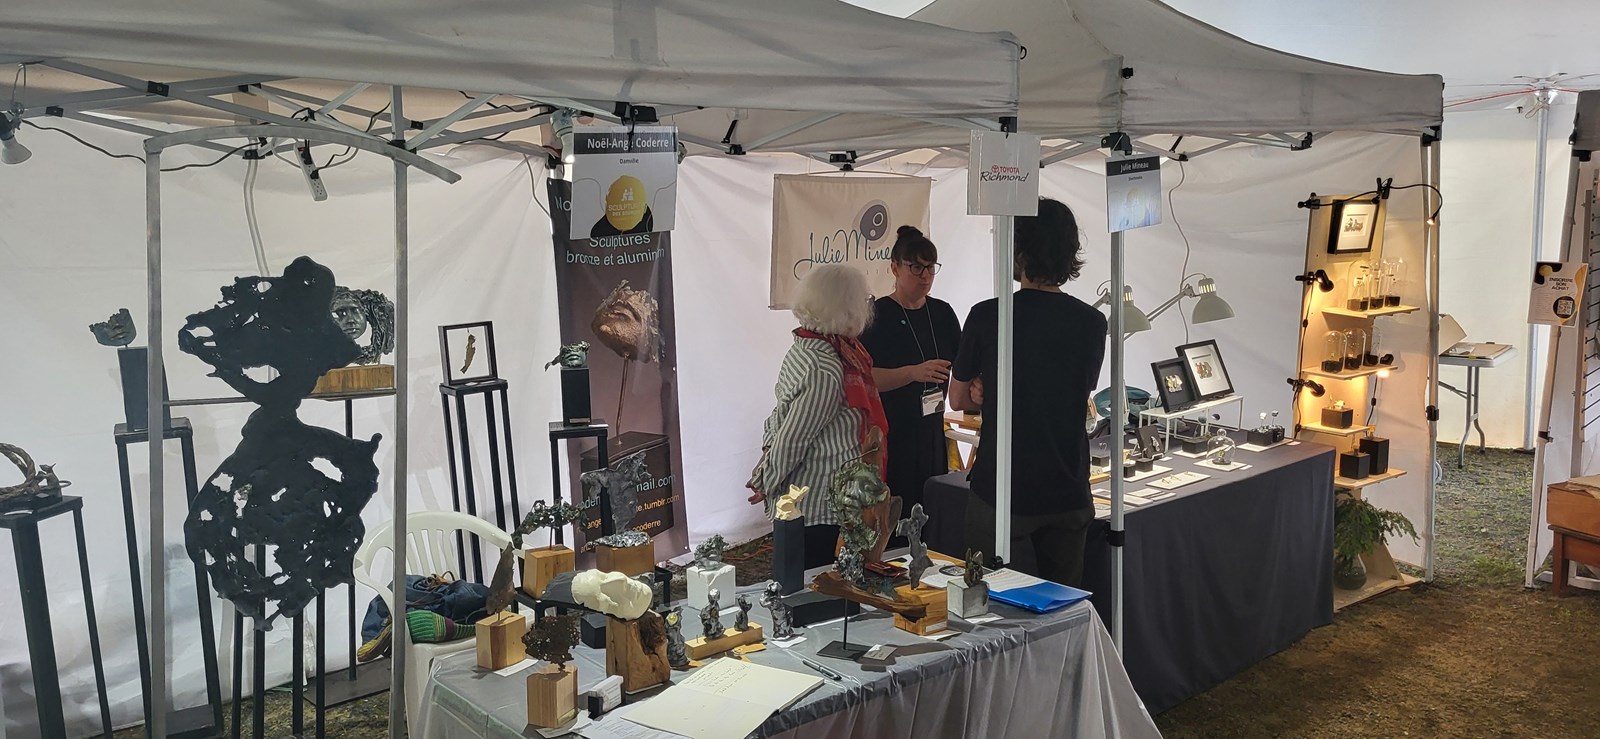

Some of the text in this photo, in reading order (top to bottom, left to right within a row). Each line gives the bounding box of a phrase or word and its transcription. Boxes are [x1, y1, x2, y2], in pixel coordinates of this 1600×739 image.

[587, 137, 669, 151] Noël-Ang Coderre
[980, 171, 1029, 182] Richmond
[1000, 166, 1020, 174] TOYOTA
[589, 234, 651, 250] Sculptures
[833, 229, 893, 262] Mine
[566, 250, 600, 266] bronze
[603, 253, 615, 266] et
